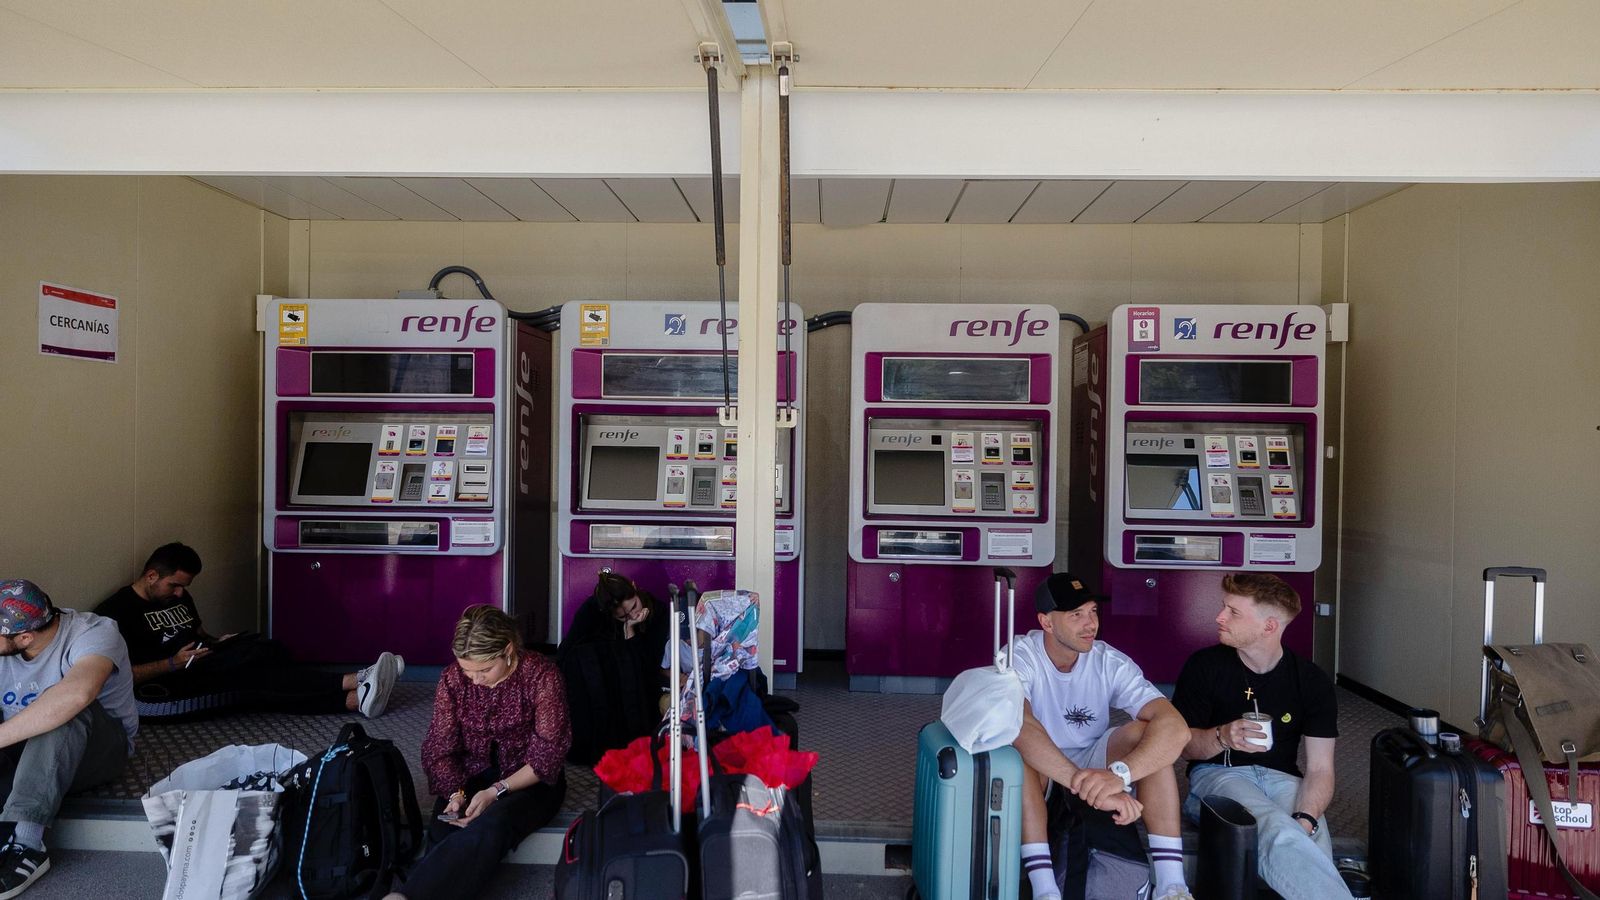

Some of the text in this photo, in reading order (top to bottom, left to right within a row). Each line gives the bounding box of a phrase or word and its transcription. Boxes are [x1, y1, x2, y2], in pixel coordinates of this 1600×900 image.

[49, 315, 110, 335] CERCANÍAS
[401, 305, 496, 343] renfe
[949, 308, 1049, 347] renfe
[1213, 311, 1317, 350] renfe
[515, 351, 534, 495] renfe
[1088, 352, 1102, 502] renfe
[599, 429, 639, 443] renfe
[881, 433, 922, 447] renfe
[1132, 437, 1174, 451] renfe
[1554, 805, 1572, 818] top
[1554, 814, 1589, 824] school
